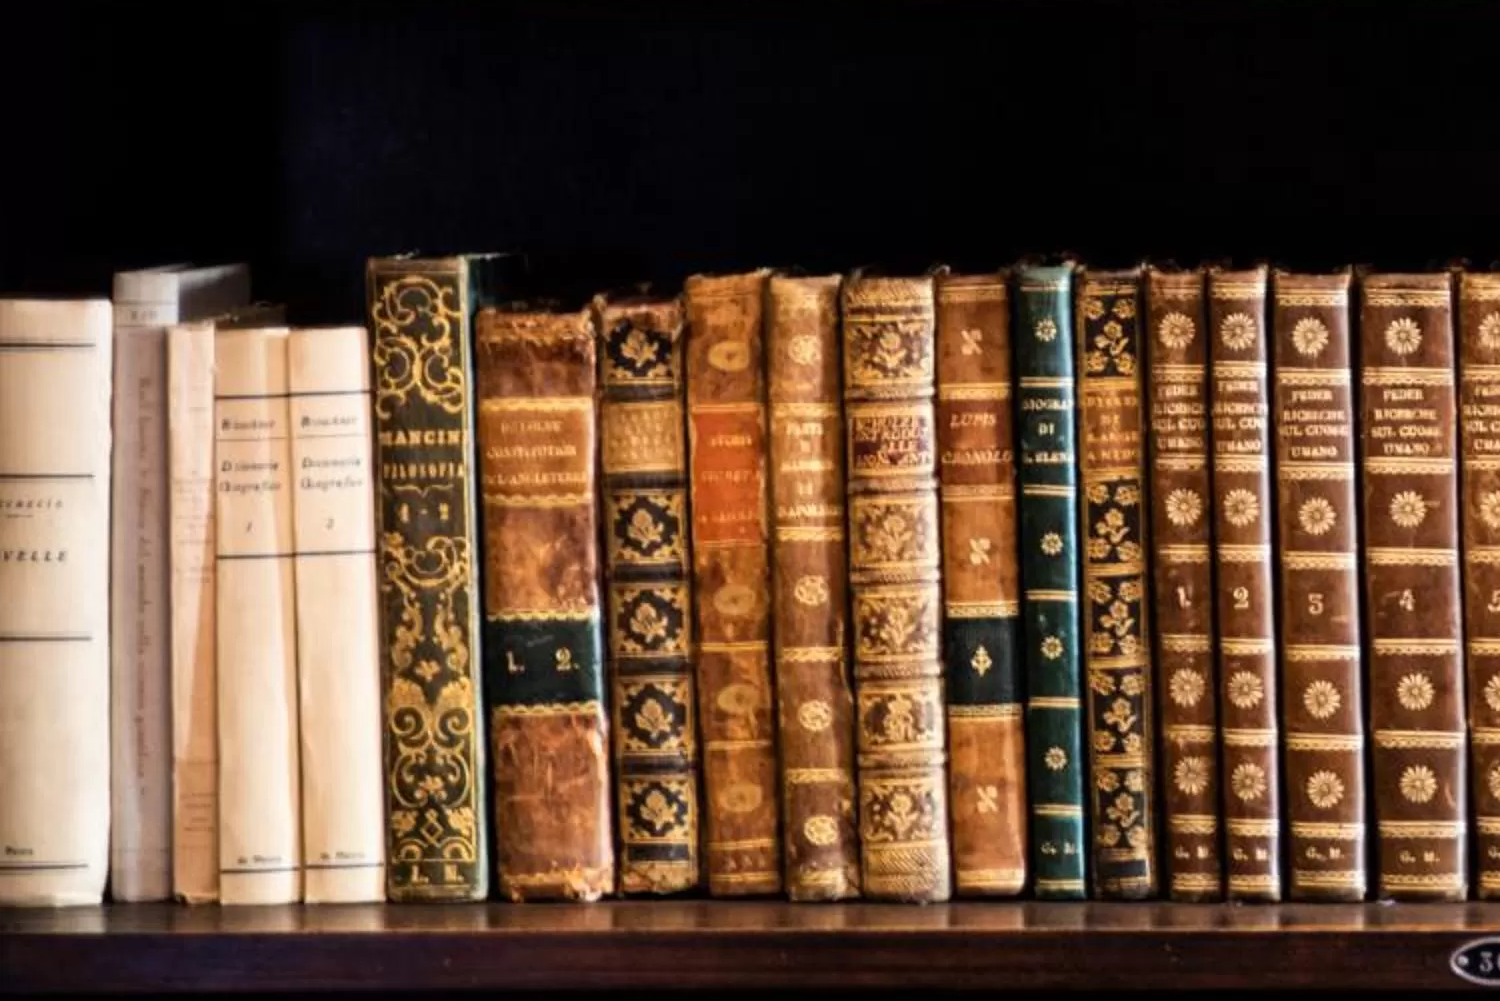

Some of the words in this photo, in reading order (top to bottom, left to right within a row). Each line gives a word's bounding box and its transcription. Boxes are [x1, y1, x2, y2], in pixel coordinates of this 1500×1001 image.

[1177, 586, 1191, 608] 1
[1233, 586, 1249, 610] 2
[1400, 588, 1415, 612] 4
